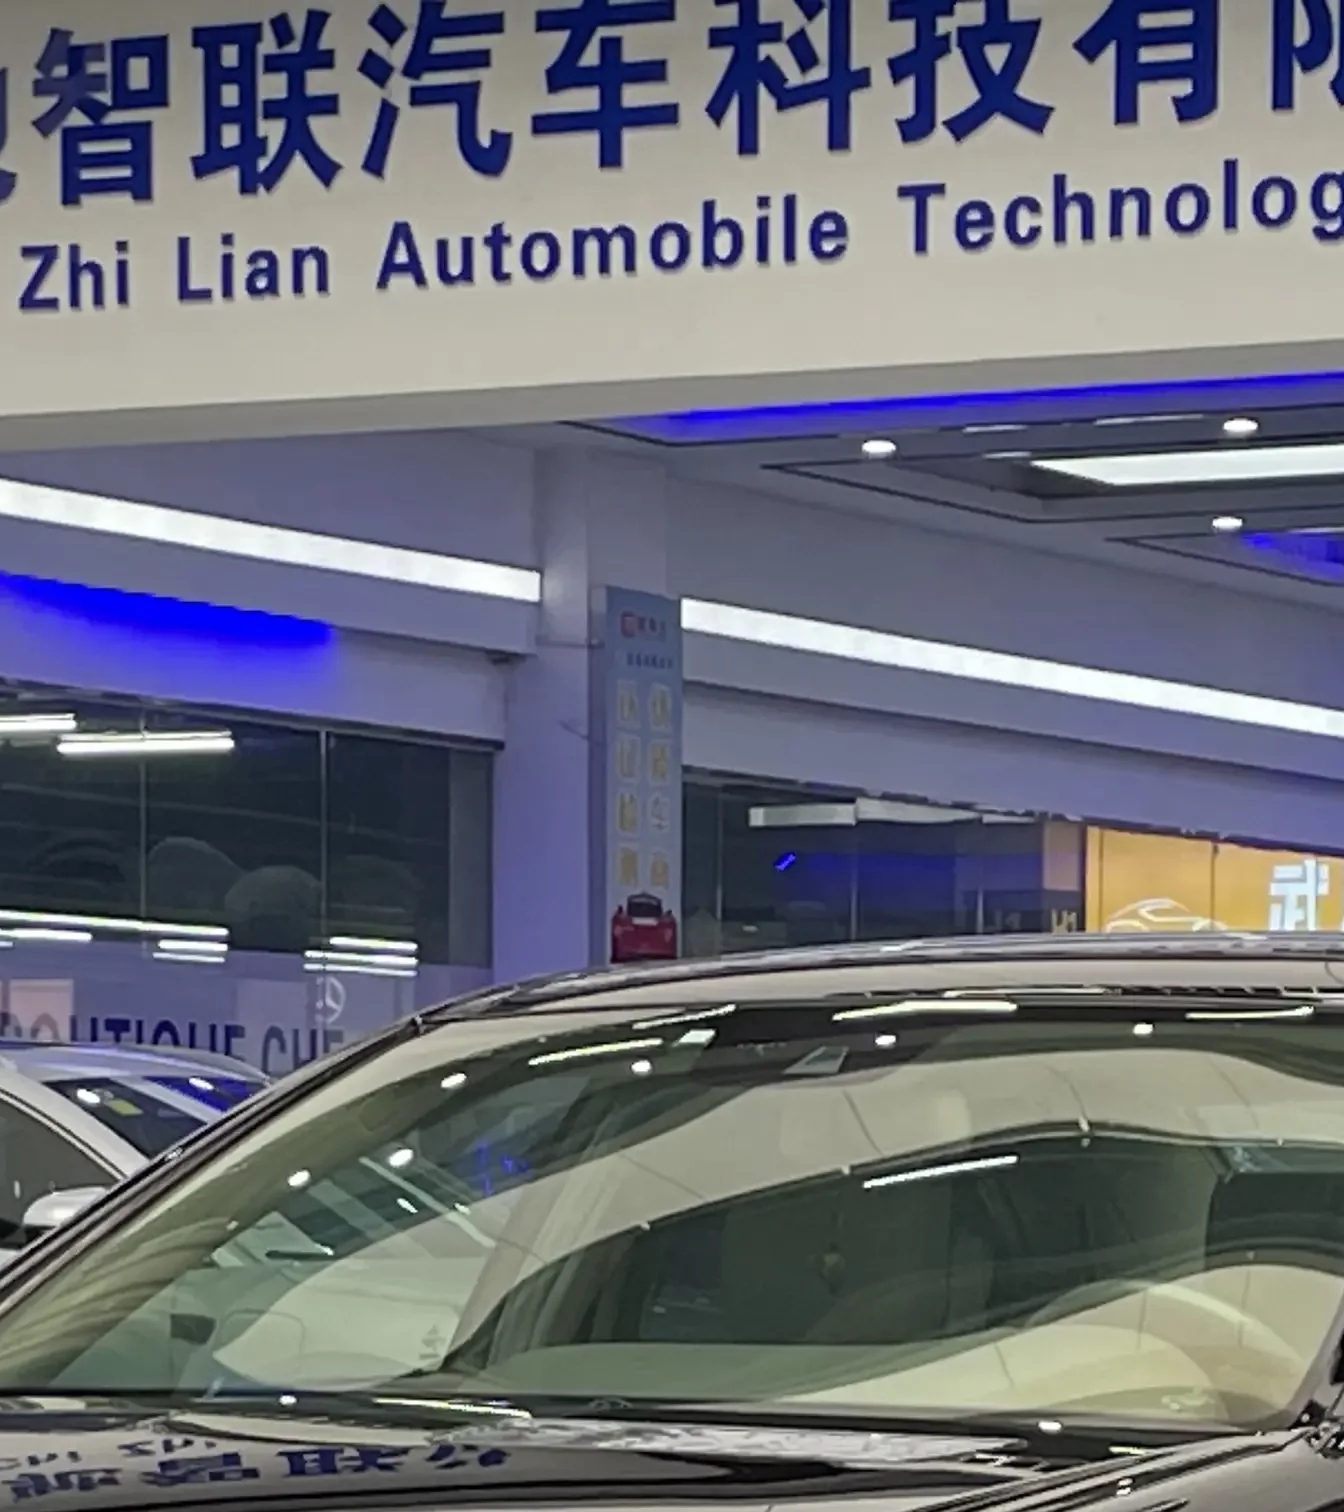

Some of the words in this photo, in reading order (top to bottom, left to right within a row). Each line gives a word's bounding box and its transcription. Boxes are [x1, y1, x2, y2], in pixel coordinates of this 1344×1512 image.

[18, 241, 130, 311] Zhi
[176, 233, 329, 301] Lian
[376, 195, 849, 289] Automobile
